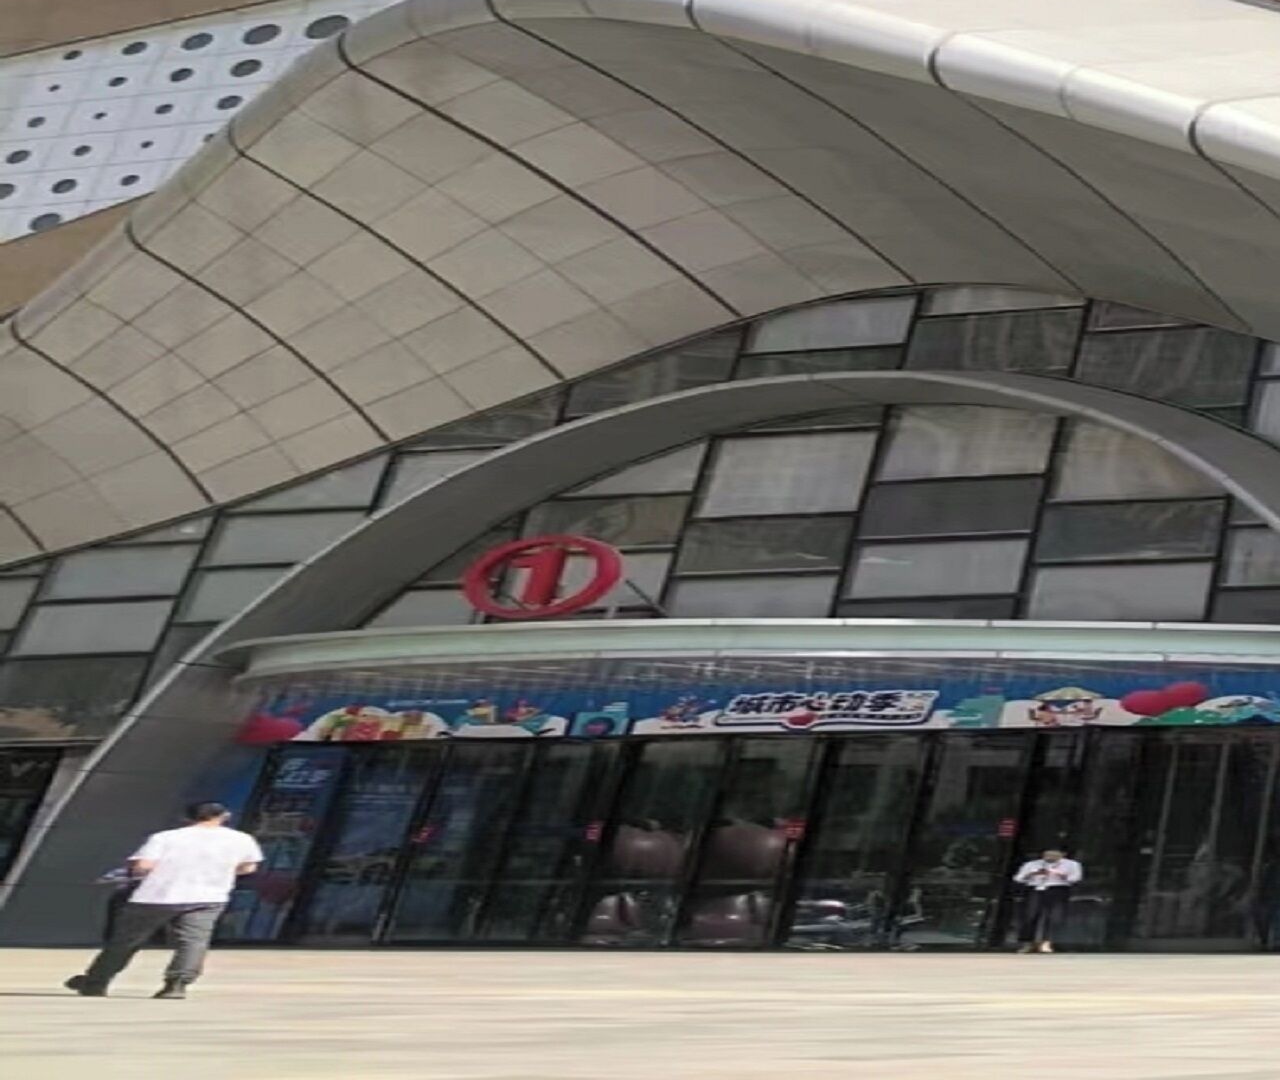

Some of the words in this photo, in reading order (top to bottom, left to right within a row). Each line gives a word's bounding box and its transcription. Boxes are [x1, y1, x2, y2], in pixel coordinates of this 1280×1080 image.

[730, 692, 900, 715] 城市心动季
